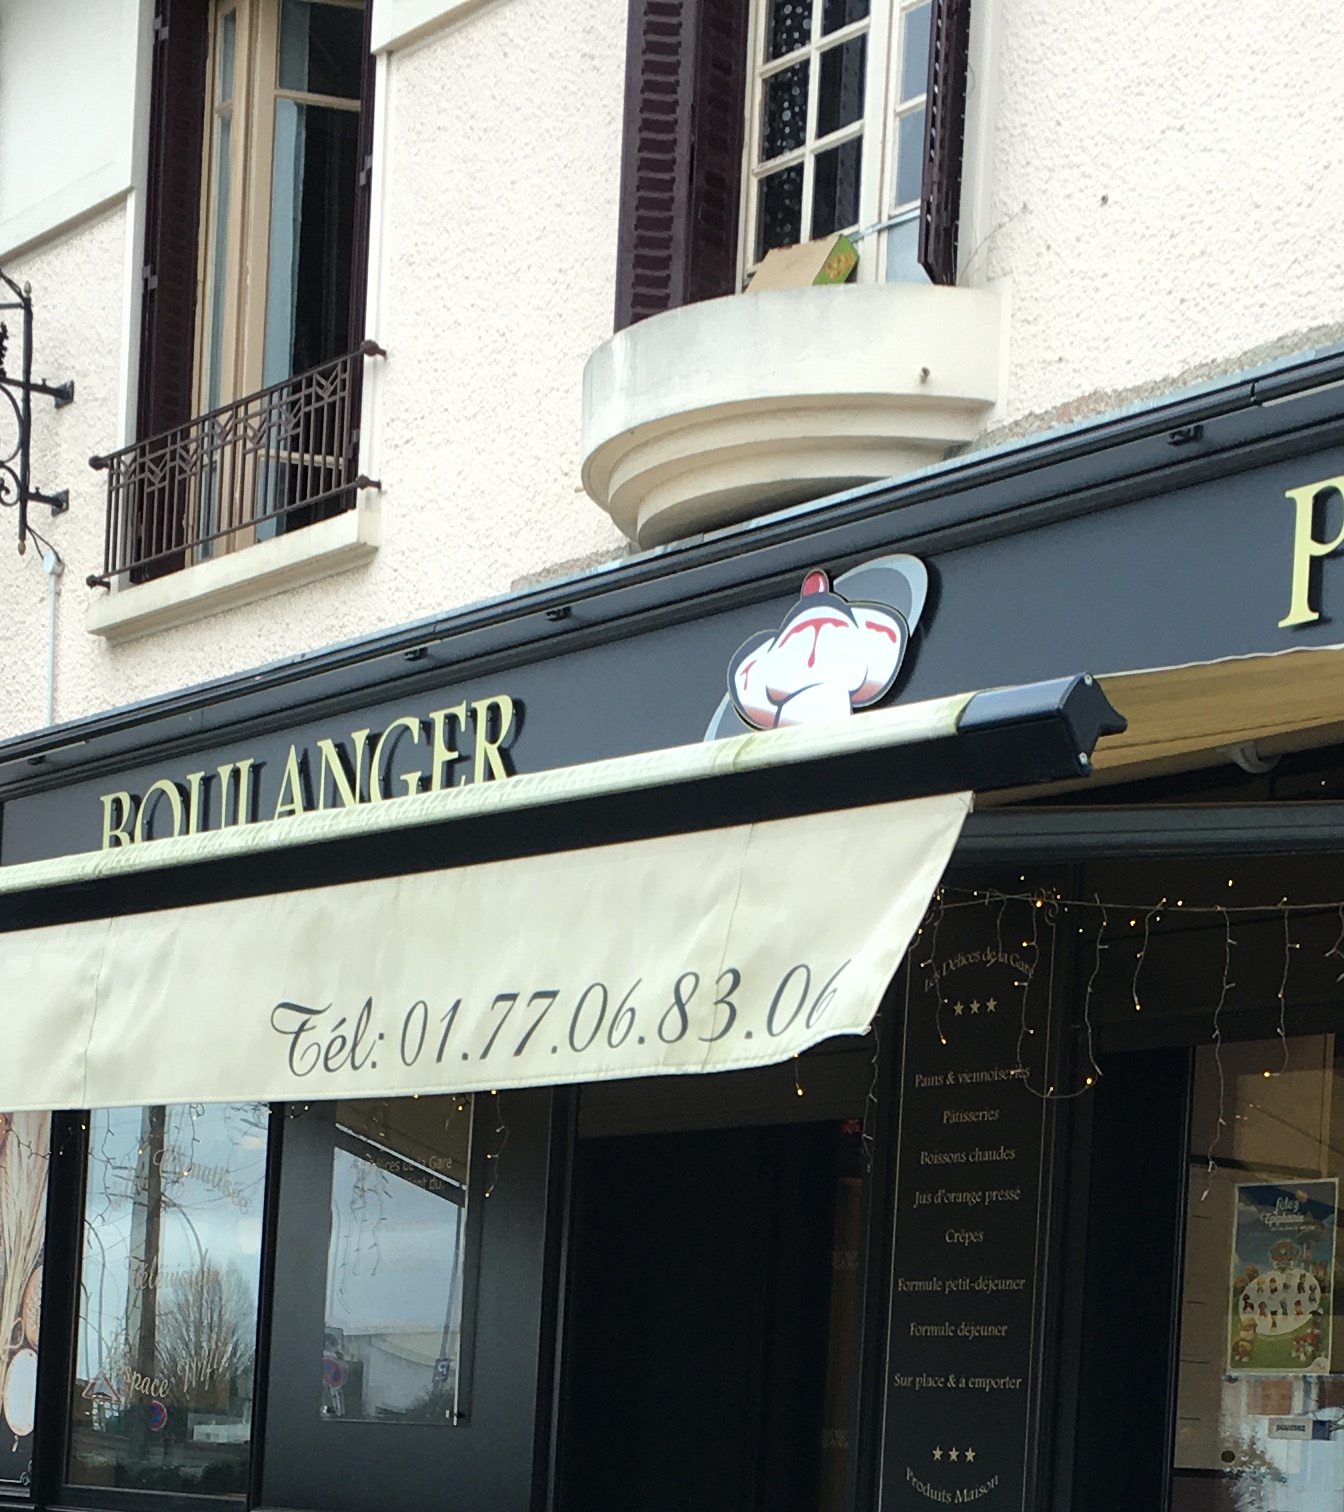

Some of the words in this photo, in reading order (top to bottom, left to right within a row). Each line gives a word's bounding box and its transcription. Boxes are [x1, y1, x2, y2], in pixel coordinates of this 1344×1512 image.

[99, 694, 513, 850] BOULANGER
[270, 996, 387, 1077] Tél:
[399, 959, 852, 1067] 01.77.06.83.06
[914, 1073, 945, 1088] Pains
[946, 1072, 956, 1086] &
[958, 1064, 1030, 1084] viennoiseries
[942, 1108, 1000, 1124] Pâtisseries
[920, 1150, 967, 1165] Boissons
[969, 1146, 1016, 1162] chaudes
[913, 1190, 931, 1208] Jus
[934, 1187, 983, 1206] d'orange
[985, 1187, 1021, 1205] pressé
[945, 1228, 984, 1244] Crêpes
[898, 1277, 943, 1292] Formule
[944, 1276, 1026, 1294] petit-déjeuner
[909, 1322, 955, 1337] Formule
[957, 1322, 1008, 1340] déjeuner
[894, 1373, 913, 1388] Sur
[915, 1374, 945, 1391] place
[947, 1374, 957, 1388] &
[968, 1375, 1022, 1392] emporter
[906, 1467, 952, 1504] Produits
[955, 1474, 999, 1504] Maison
